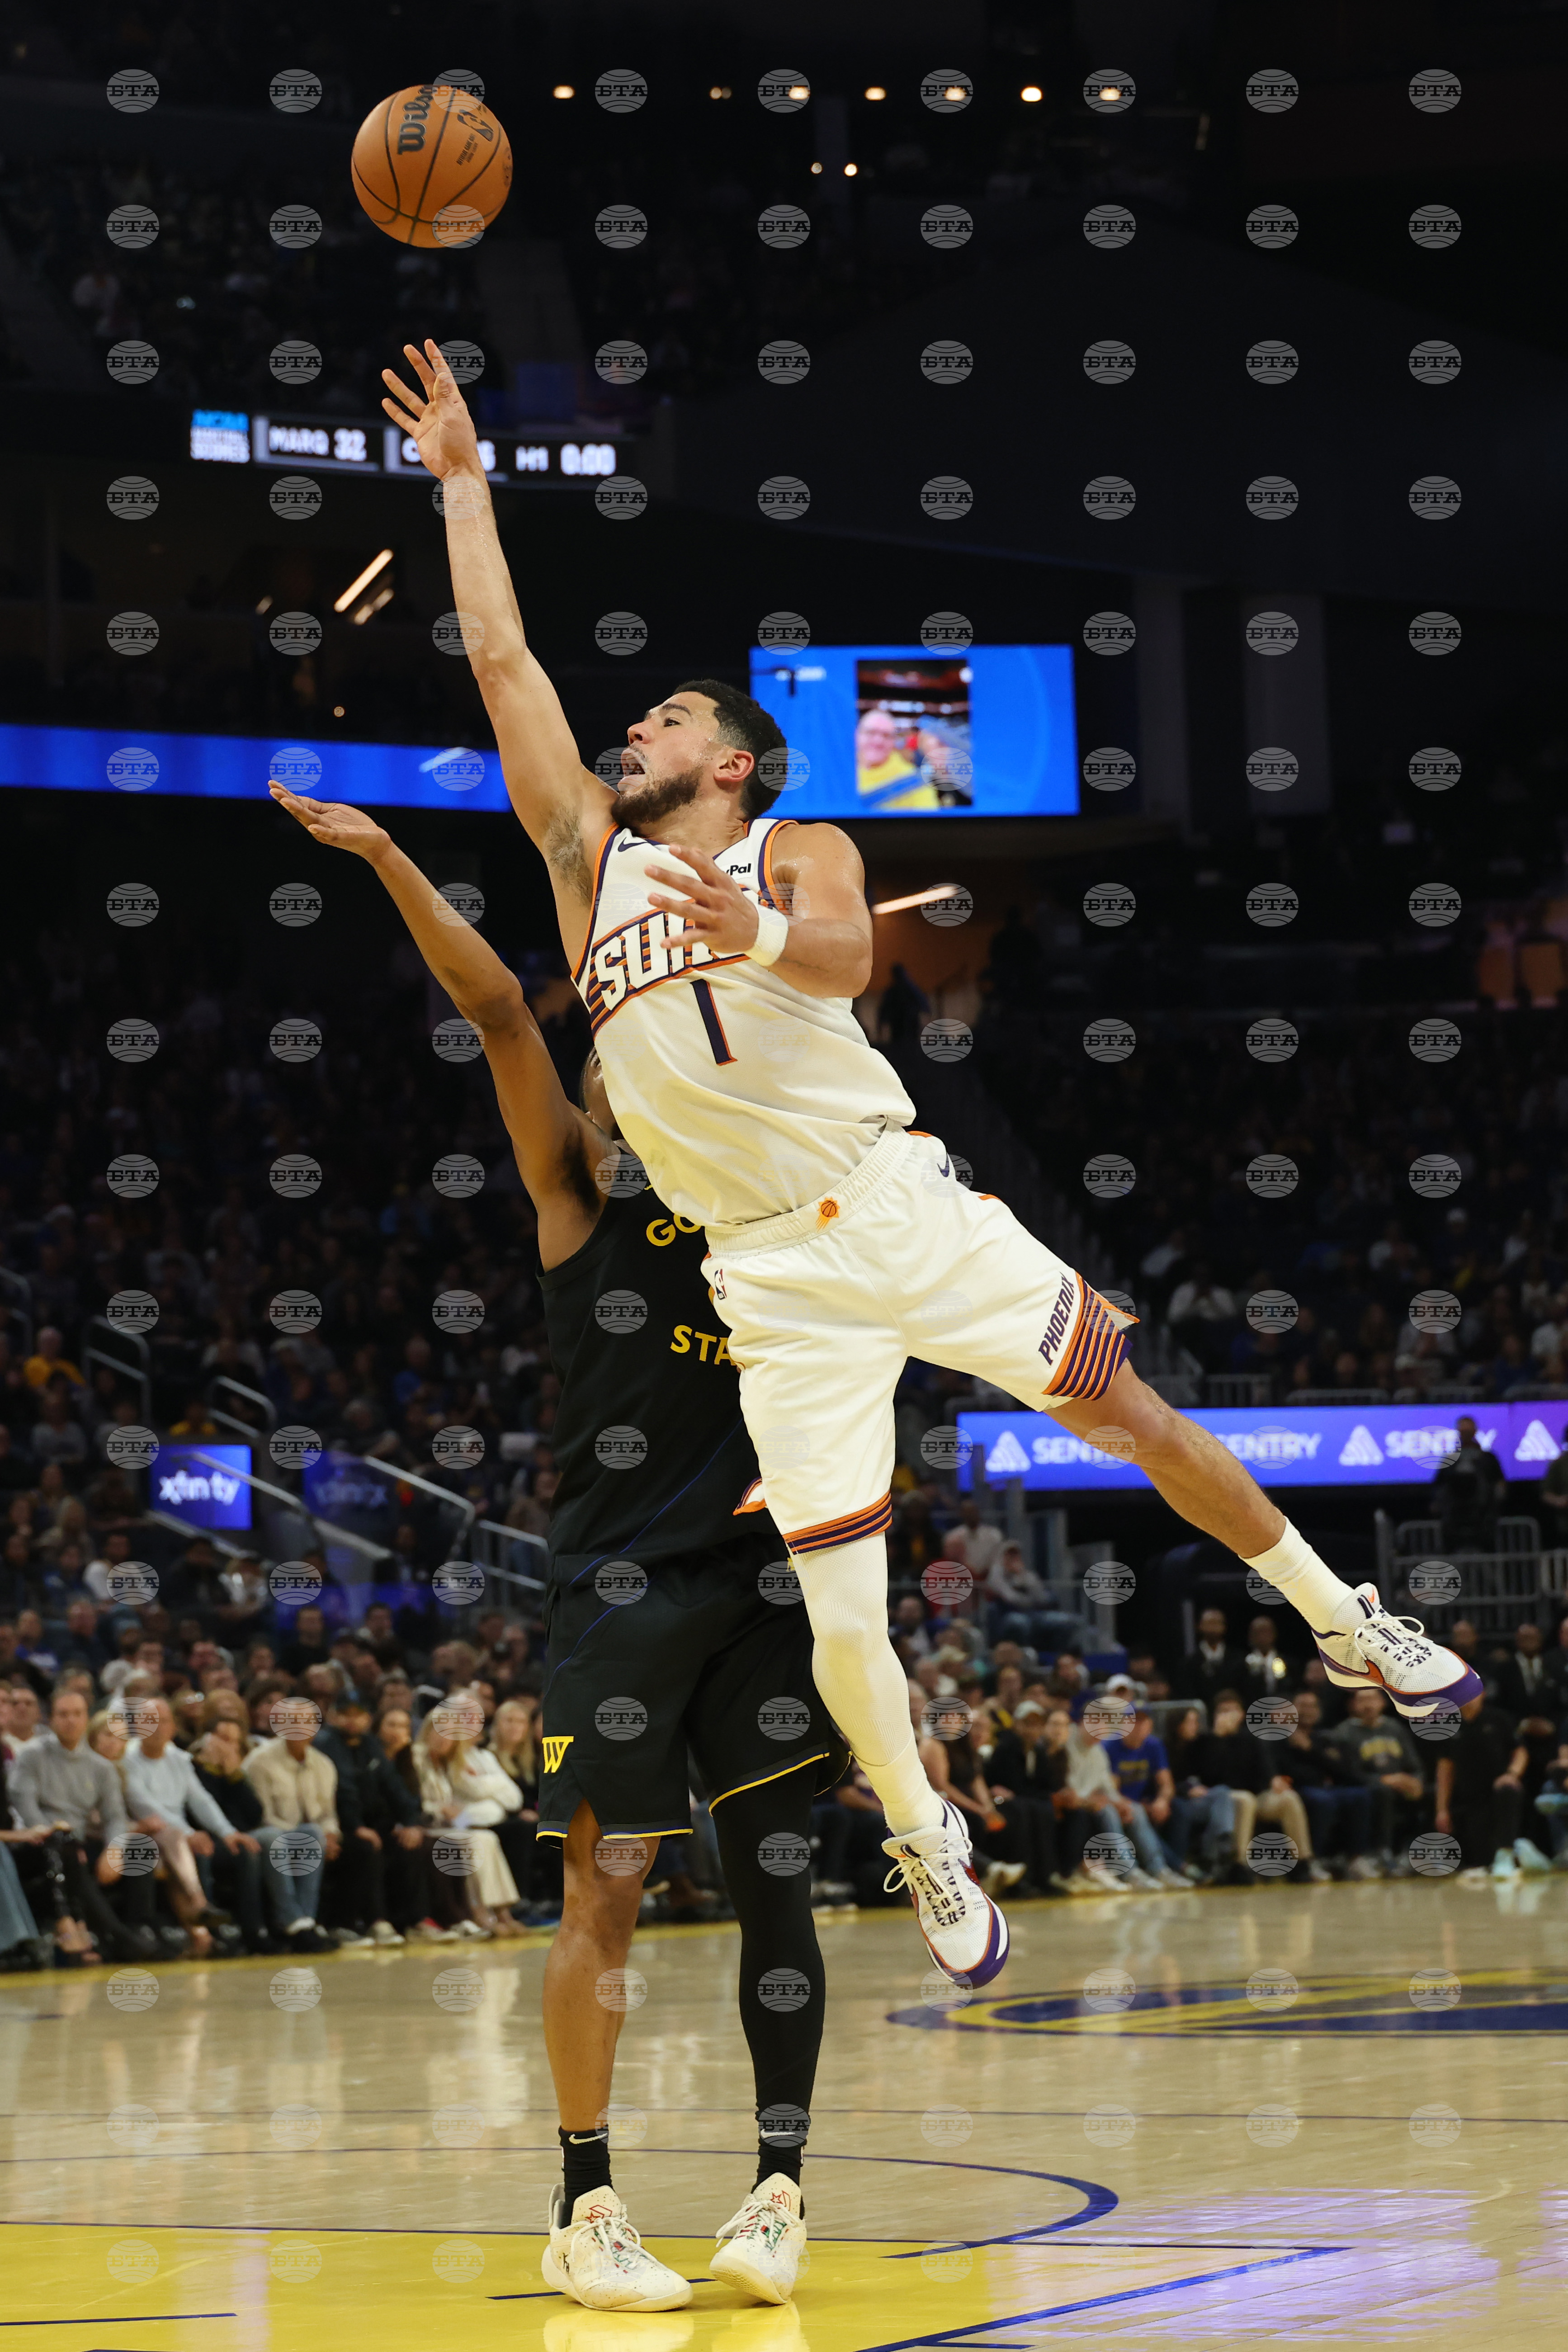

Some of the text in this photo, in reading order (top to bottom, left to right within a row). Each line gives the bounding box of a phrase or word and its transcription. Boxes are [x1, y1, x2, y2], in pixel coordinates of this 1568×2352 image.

[726, 863, 751, 876] Pal
[690, 979, 737, 1066] 1
[670, 1325, 737, 1366] STA
[1038, 1271, 1074, 1366] PHOENIX
